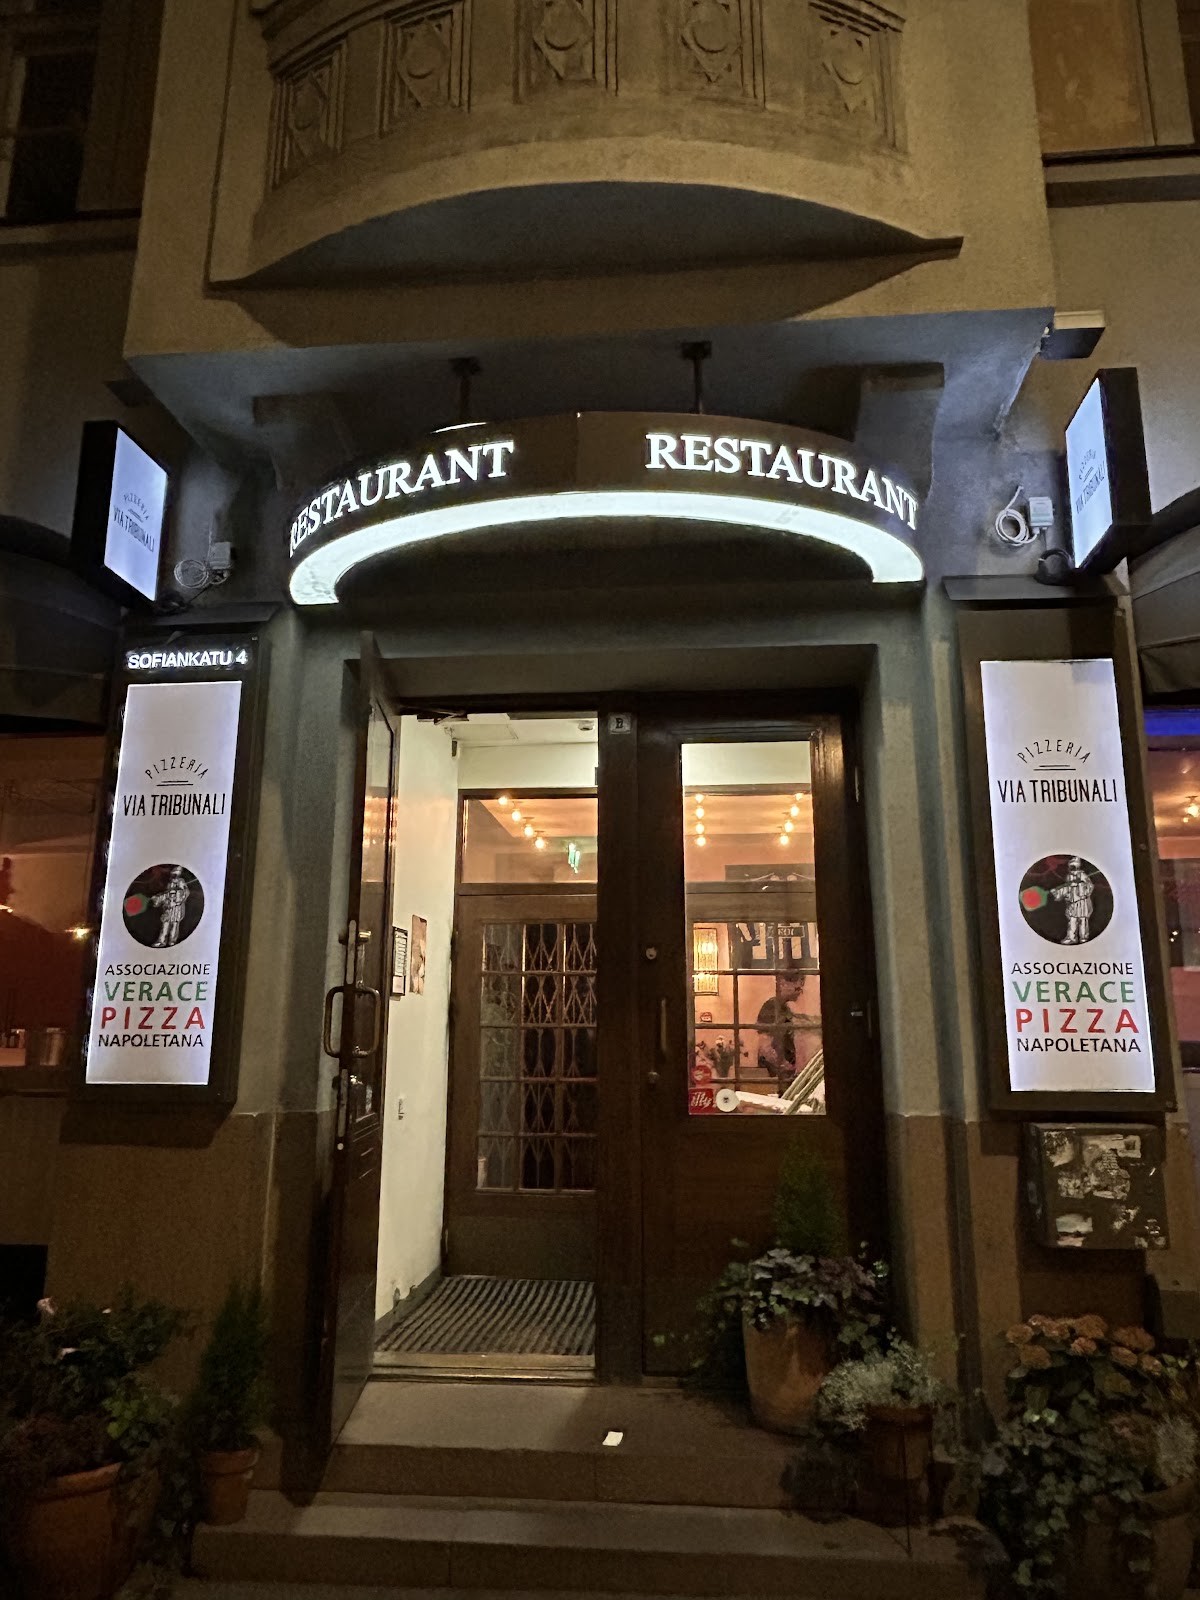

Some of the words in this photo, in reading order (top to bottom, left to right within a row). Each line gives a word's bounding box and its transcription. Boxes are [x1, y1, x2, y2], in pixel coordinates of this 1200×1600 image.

[646, 434, 918, 530] RESTAURANT
[289, 440, 514, 558] RESTAURANT
[127, 651, 232, 669] SOFIANKATU
[236, 649, 248, 665] 4
[1017, 739, 1091, 764] PIZZERIA
[145, 756, 208, 779] PIZZERIA
[997, 779, 1026, 803] VIA
[1029, 778, 1118, 803] TRIBUNALI
[123, 794, 146, 816] VIA
[150, 793, 226, 816] TRIBUNALI
[105, 963, 211, 976] ASSOCIAZIONE
[1011, 962, 1134, 975] ASSOCIAZIONE
[104, 981, 208, 1002] VERACE
[1012, 981, 1136, 1003] VERACE
[101, 1006, 206, 1030] PIZZA
[1015, 1008, 1140, 1034] PIZZA
[98, 1033, 204, 1048] NAPOLETANA
[1016, 1038, 1142, 1053] NAPOLETANA
